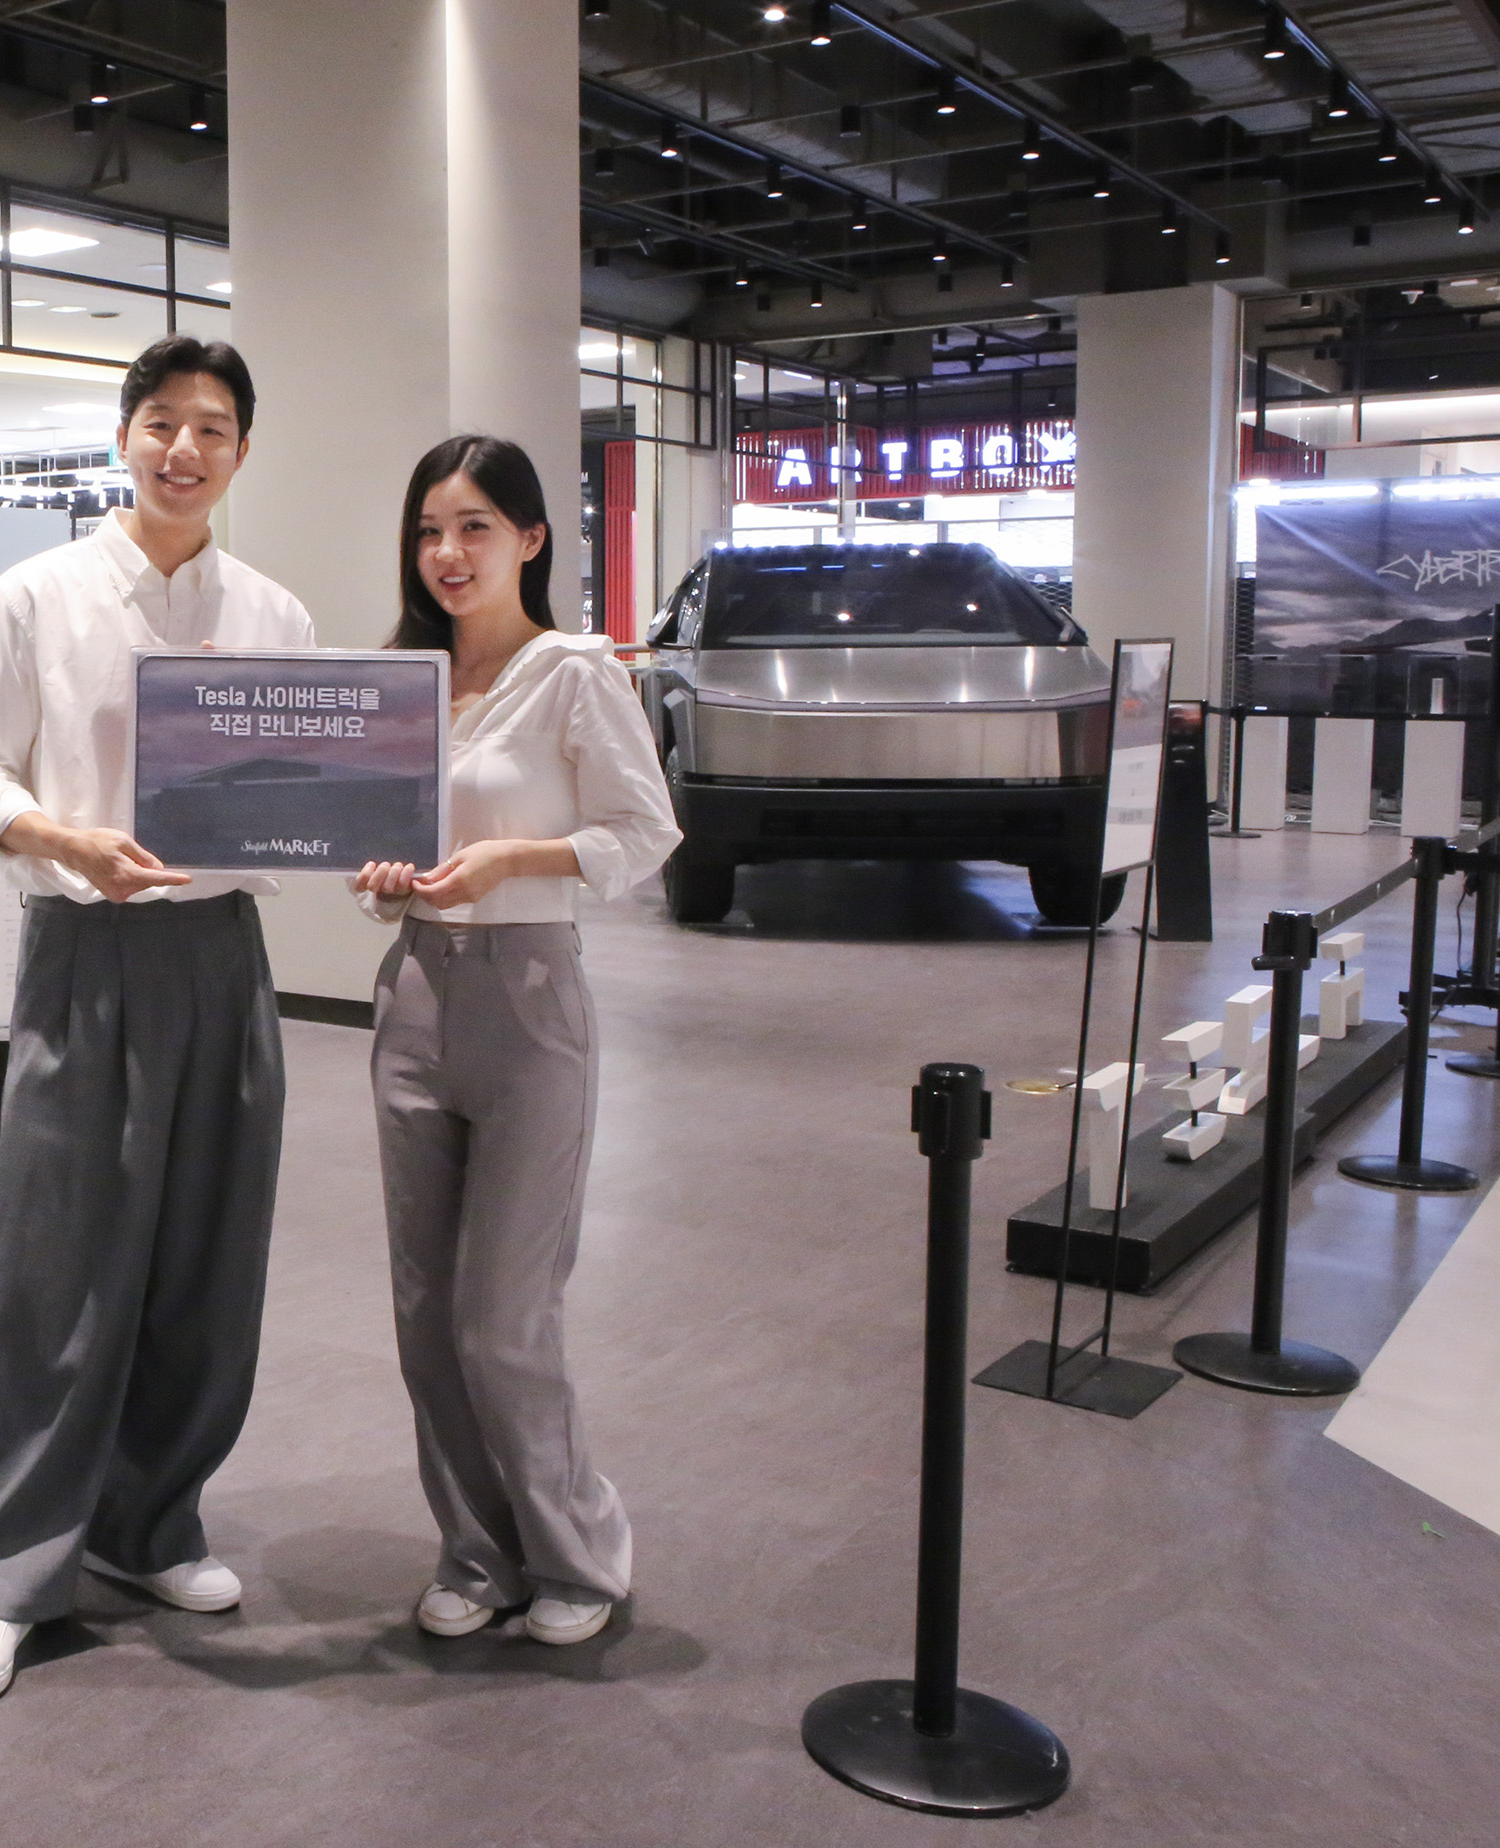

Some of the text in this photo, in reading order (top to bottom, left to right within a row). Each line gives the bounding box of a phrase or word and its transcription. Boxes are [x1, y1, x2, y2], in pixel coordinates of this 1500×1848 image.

[776, 430, 1076, 488] ARTBOX
[194, 686, 380, 711] Tesla 사이버트럭을
[209, 713, 366, 738] 직접 만나보세요
[269, 838, 331, 856] MARKET
